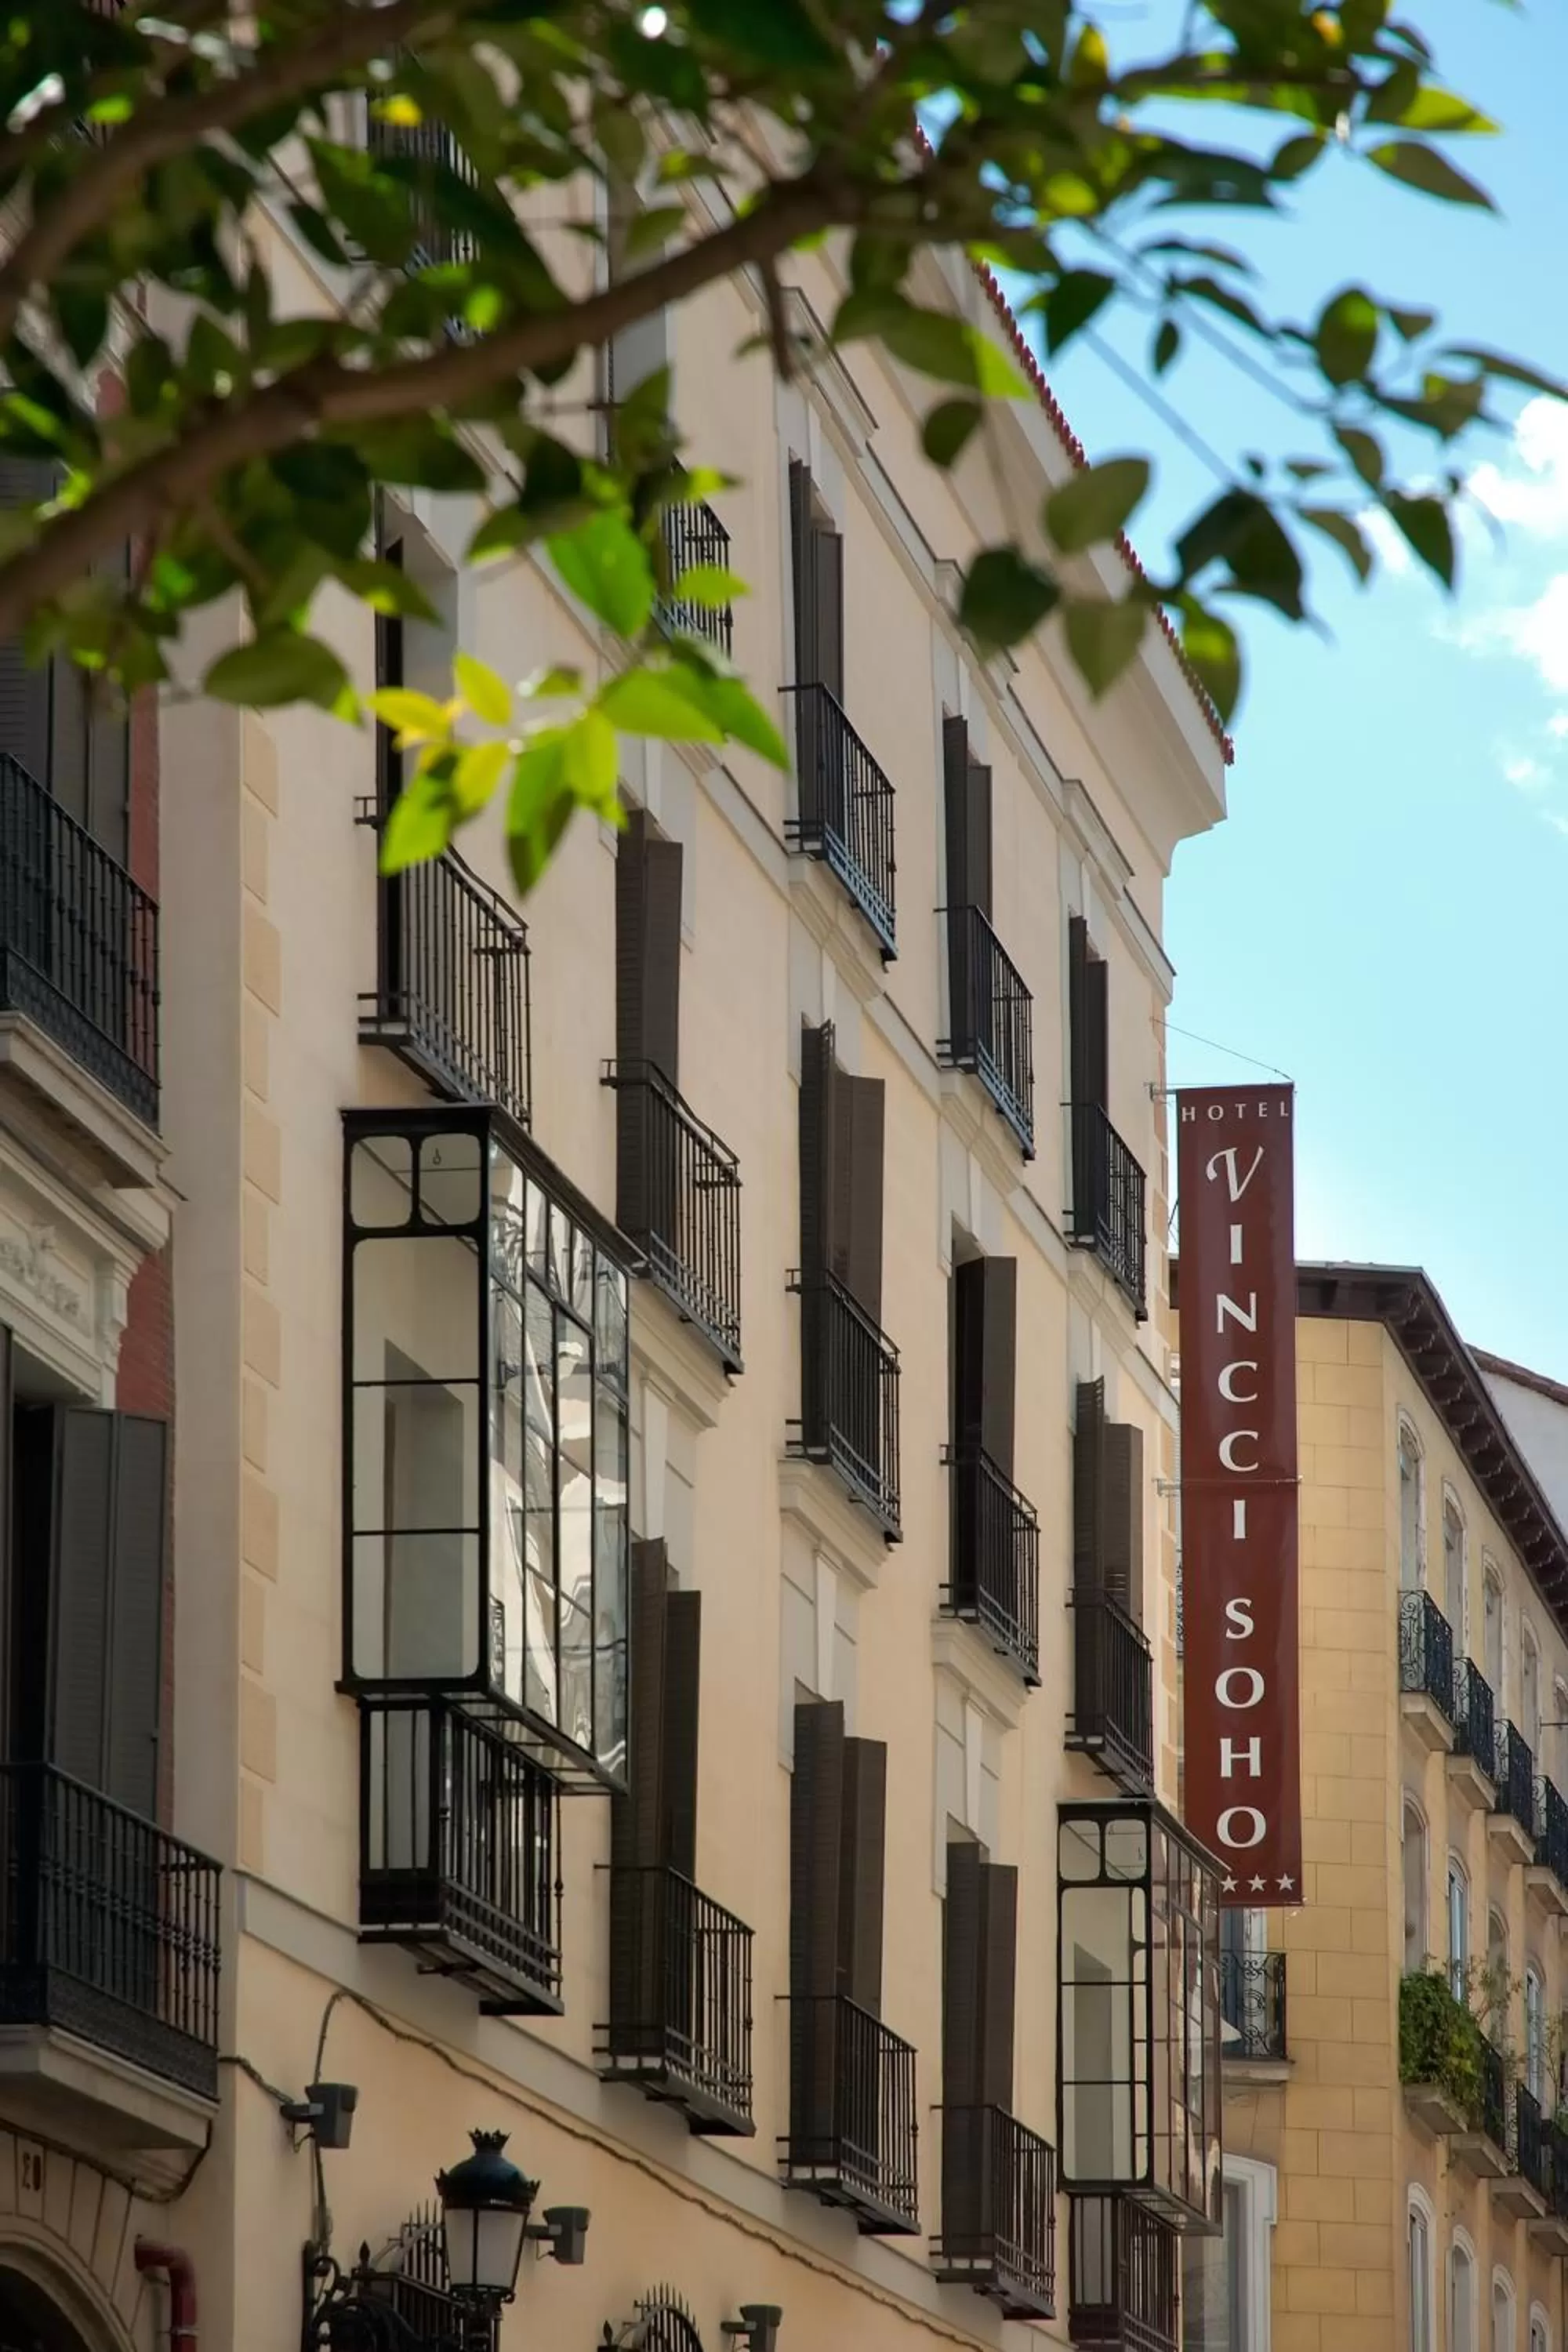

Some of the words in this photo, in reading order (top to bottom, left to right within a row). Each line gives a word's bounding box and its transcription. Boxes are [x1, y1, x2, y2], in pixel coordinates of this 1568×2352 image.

[1181, 1101, 1289, 1123] HOTEL
[1205, 1145, 1264, 1540] VINCCI
[1214, 1598, 1267, 1849] SOHO
